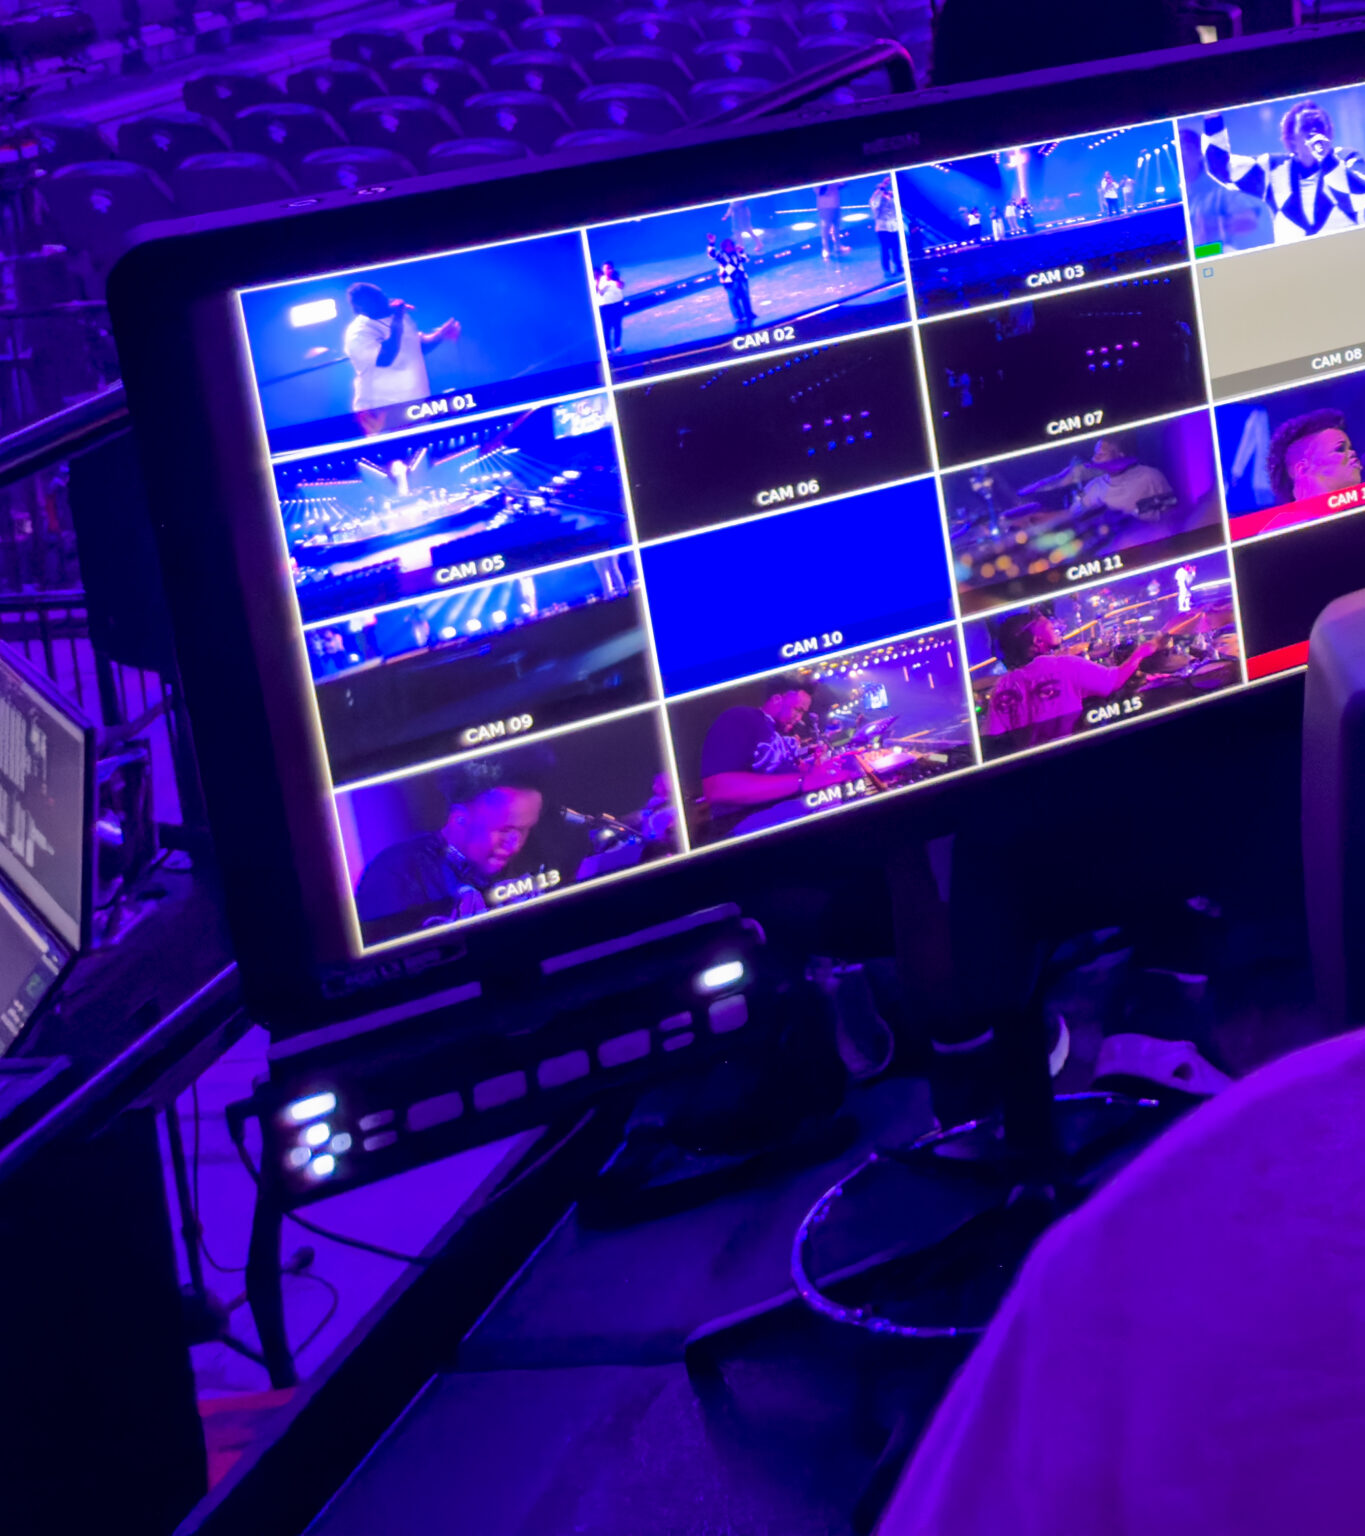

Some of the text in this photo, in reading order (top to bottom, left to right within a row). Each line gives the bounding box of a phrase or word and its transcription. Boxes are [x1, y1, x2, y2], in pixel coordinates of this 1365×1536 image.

[1029, 264, 1085, 289] CAM 03
[731, 326, 795, 350] CAM 02
[1311, 348, 1363, 370] CAM 08
[405, 392, 478, 420] CAM 01
[1046, 410, 1104, 435] CAM 07
[756, 479, 821, 506] CAM 06
[1327, 490, 1358, 508] CAM
[435, 554, 505, 584] CAM 05
[1066, 553, 1124, 580] CAM 11
[781, 630, 844, 658] CAM 10
[1086, 695, 1144, 723] CAM 15
[463, 713, 534, 744] CAM 09
[804, 778, 868, 807] CAM 14
[491, 869, 561, 901] CAM 13
